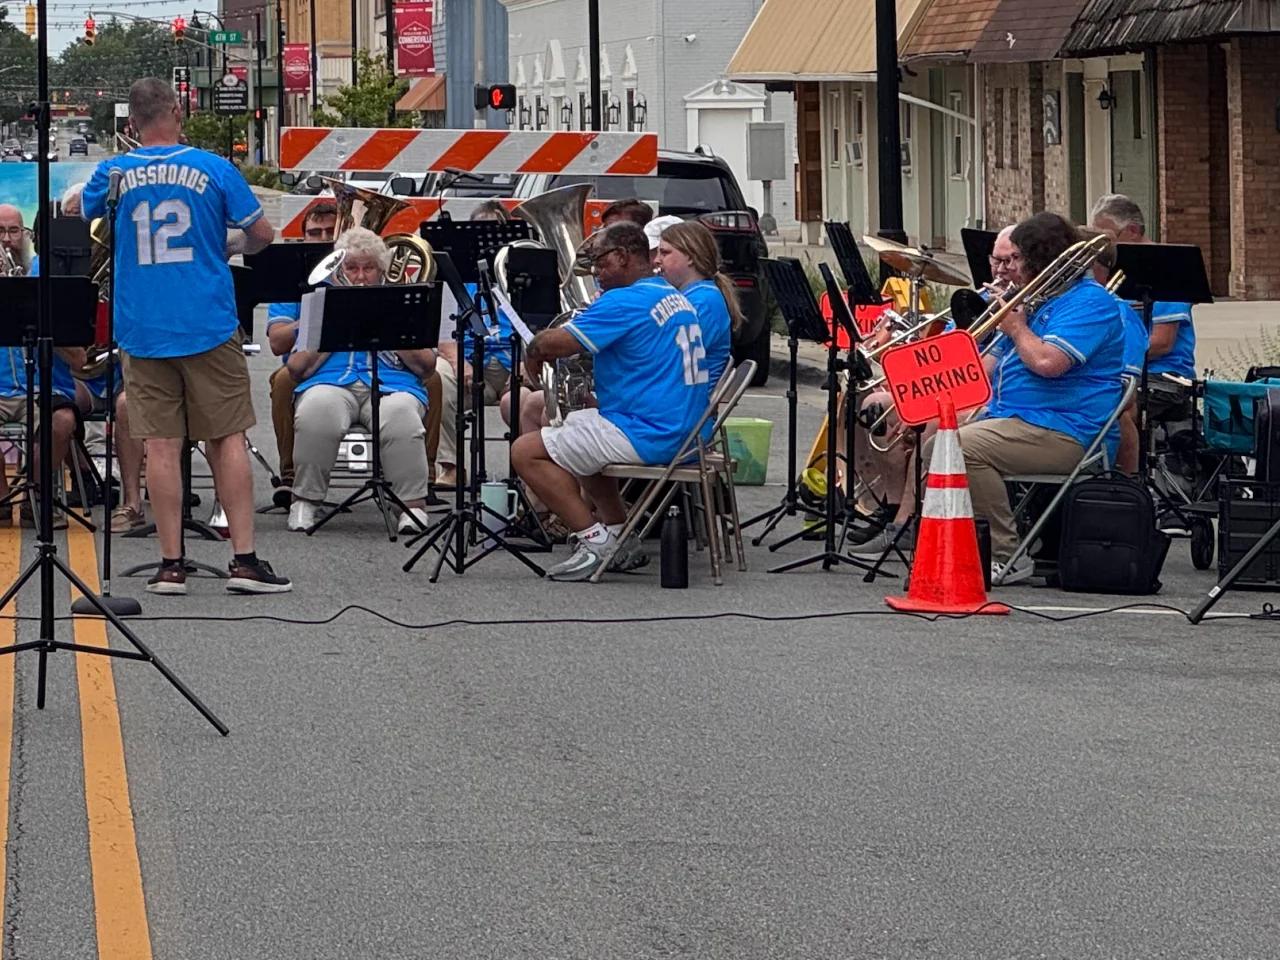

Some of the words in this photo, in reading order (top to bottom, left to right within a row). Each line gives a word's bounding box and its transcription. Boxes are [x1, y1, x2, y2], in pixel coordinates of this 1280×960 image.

[229, 33, 237, 41] ST
[119, 163, 210, 195] ROSSROADS
[131, 199, 194, 266] 12
[675, 323, 710, 386] 12
[913, 344, 942, 368] NO
[895, 363, 980, 404] PARKING
